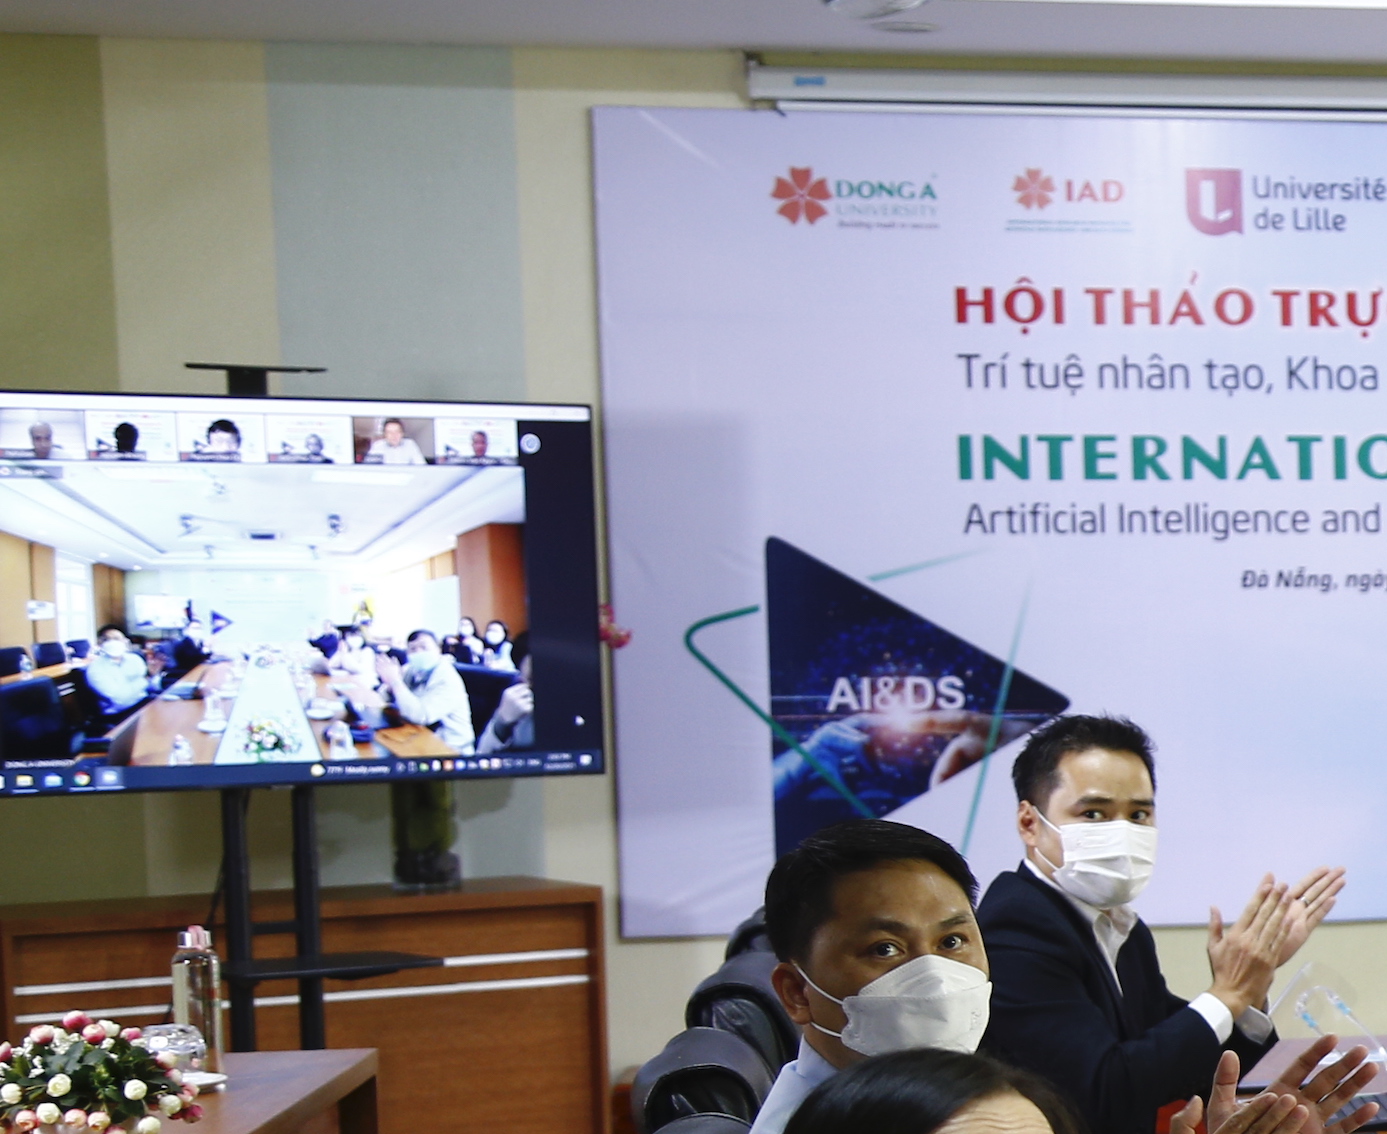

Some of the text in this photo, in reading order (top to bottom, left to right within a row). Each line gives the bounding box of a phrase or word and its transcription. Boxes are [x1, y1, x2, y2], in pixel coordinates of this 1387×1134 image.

[1065, 179, 1126, 202] IAD
[1253, 175, 1387, 202] Université
[1254, 207, 1347, 233] de Lille
[954, 277, 1066, 336] HỘI
[1084, 272, 1255, 327] THẢO
[957, 353, 1010, 390] Trí
[1021, 354, 1086, 397] tuệ
[1098, 353, 1192, 391] nhân
[1204, 359, 1275, 398] tạo,
[1286, 356, 1381, 392] Khoa
[963, 502, 1108, 536] Artificial
[1118, 503, 1312, 542] Intelligence
[1321, 503, 1383, 535] and
[1241, 569, 1270, 589] Đà
[826, 674, 967, 713] AI&DS
